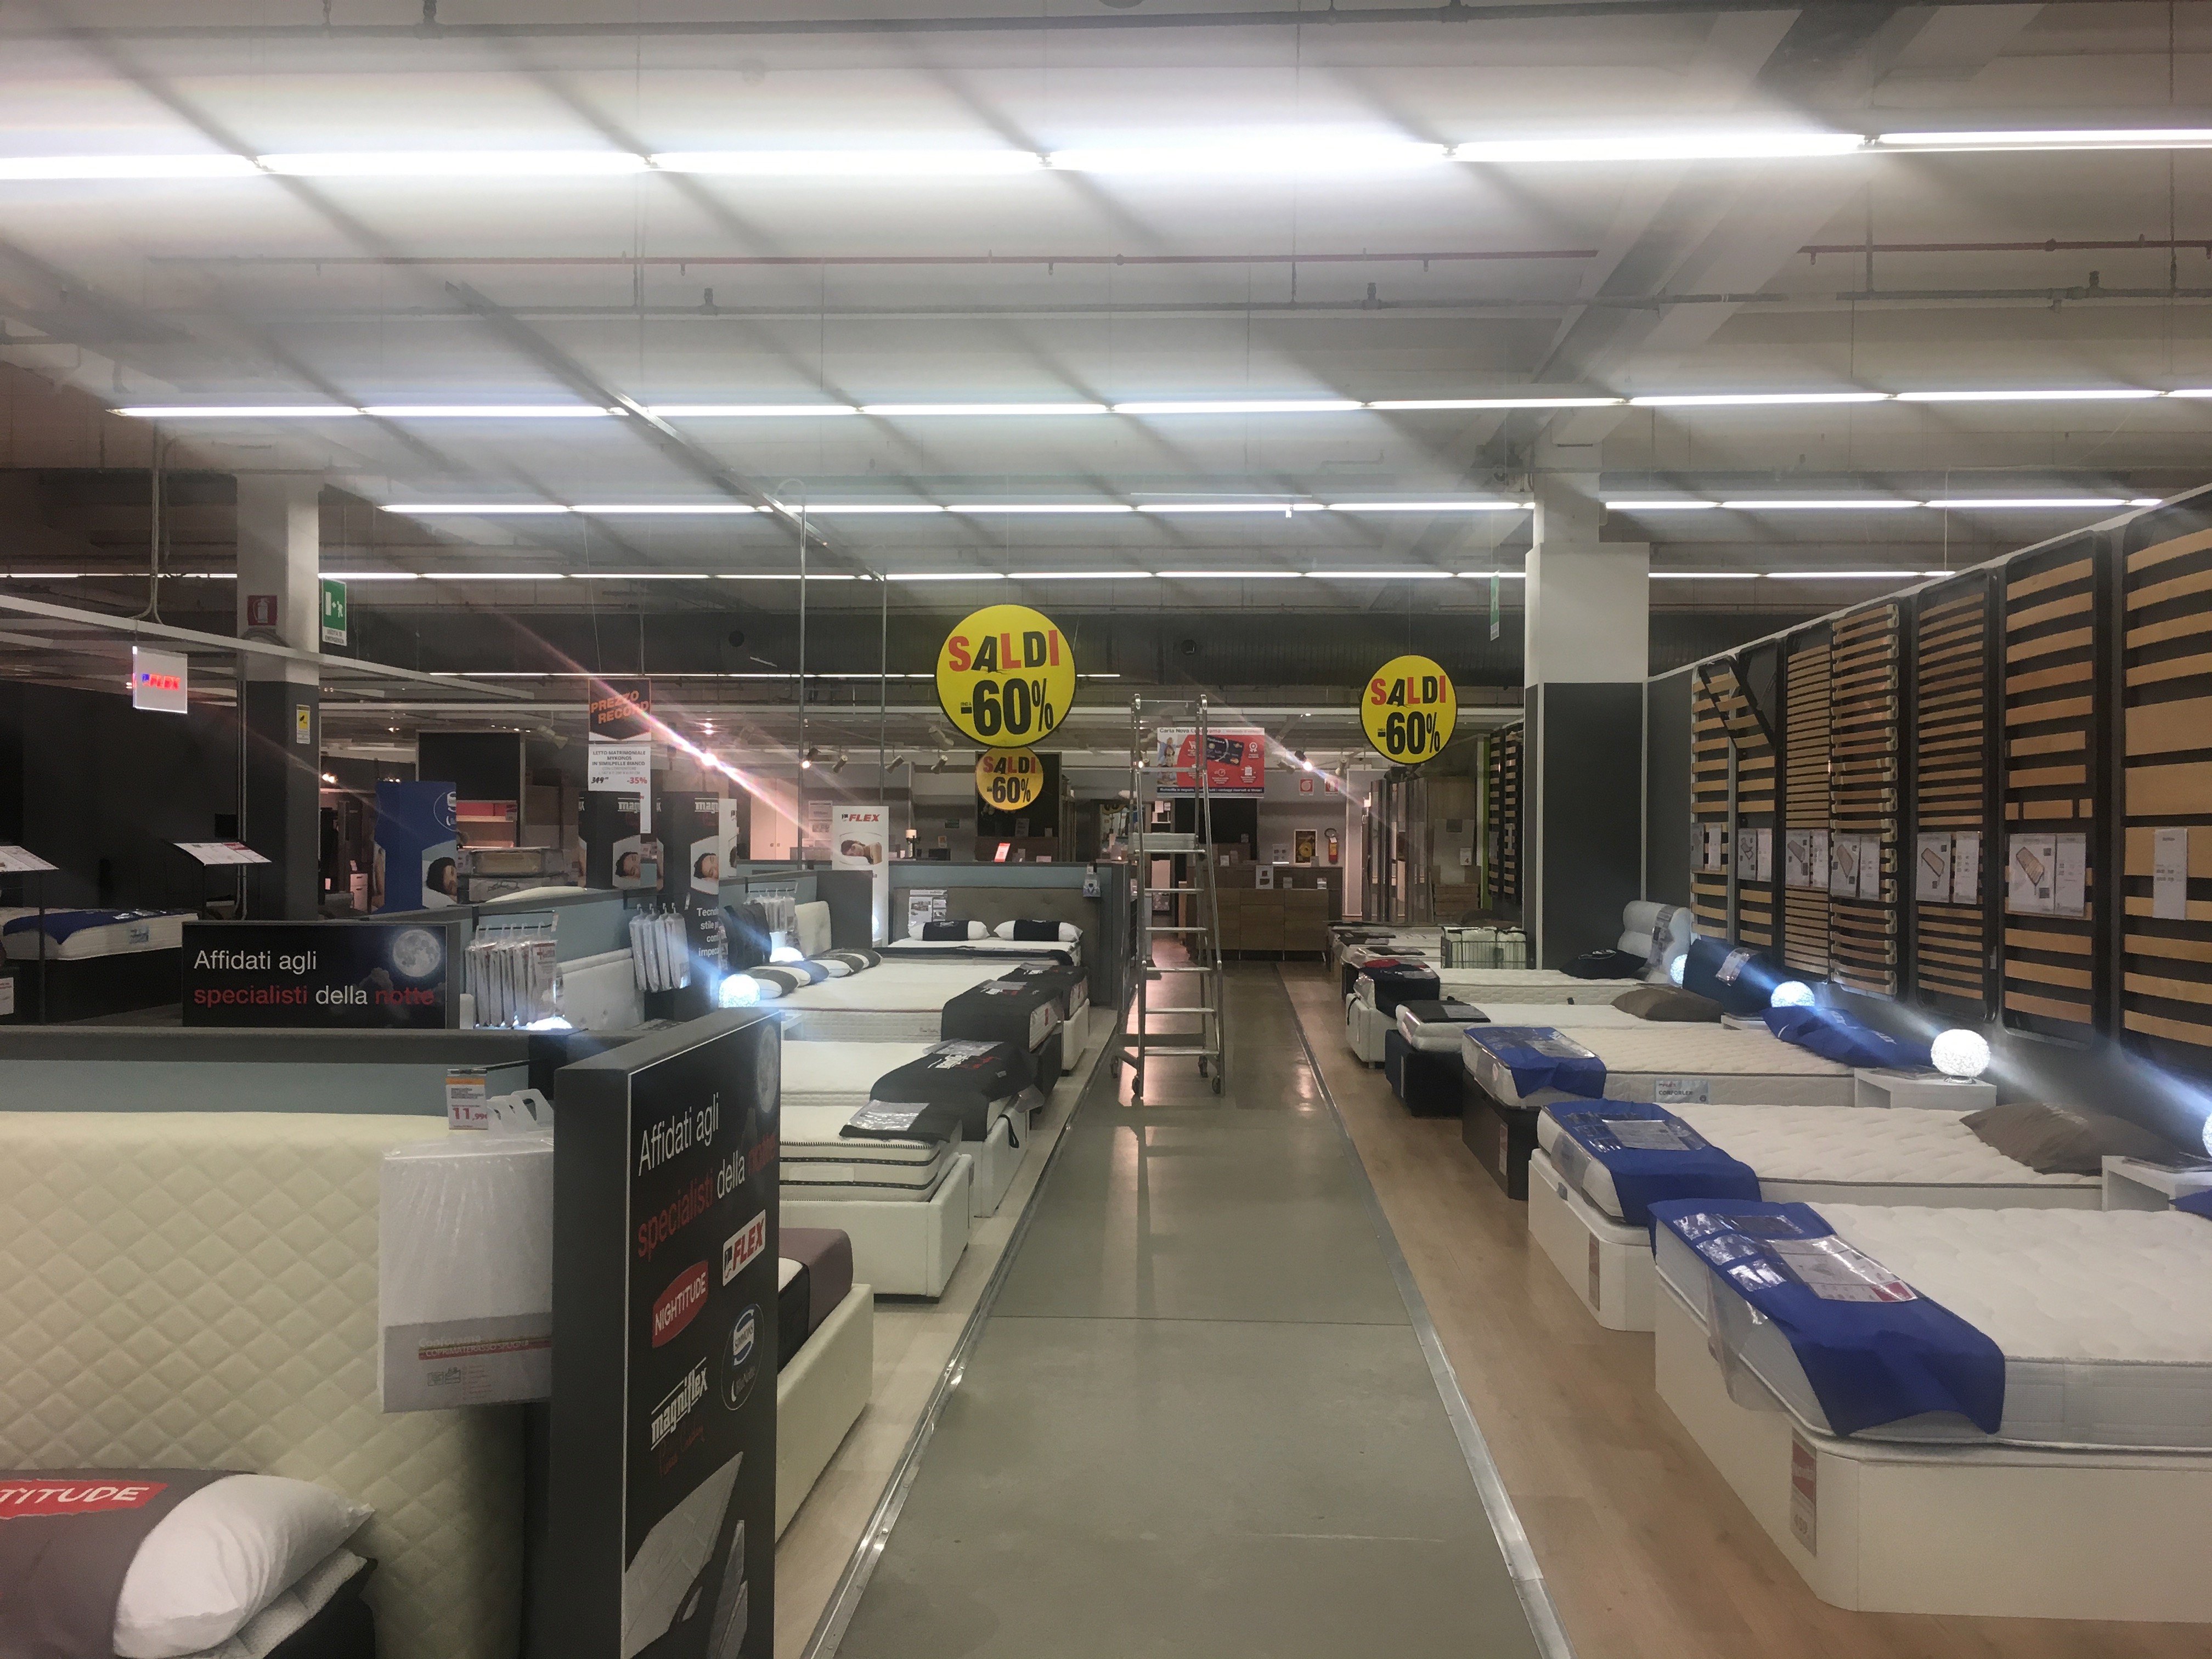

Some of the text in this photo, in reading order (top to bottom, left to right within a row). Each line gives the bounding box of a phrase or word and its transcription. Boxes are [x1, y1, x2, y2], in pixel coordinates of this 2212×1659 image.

[949, 630, 1059, 672] SALDI
[591, 690, 639, 713] PREZZO
[961, 678, 1053, 736] -60%
[1371, 675, 1446, 707] SALDI
[1378, 711, 1440, 754] -60%
[983, 757, 1036, 774] SALDI
[987, 776, 1031, 803] -60%
[849, 814, 880, 822] FLEX
[194, 950, 317, 974] Affidati agli
[194, 985, 434, 1008] specialisti della notte
[638, 1092, 719, 1177] Affidati agli
[638, 1167, 713, 1262] specialisti
[717, 1150, 745, 1199] della
[733, 1217, 764, 1271] FLEX
[655, 1272, 706, 1336] NIGHTITUDE
[651, 1368, 708, 1445] magniflex
[0, 1487, 150, 1504] TITUDE
